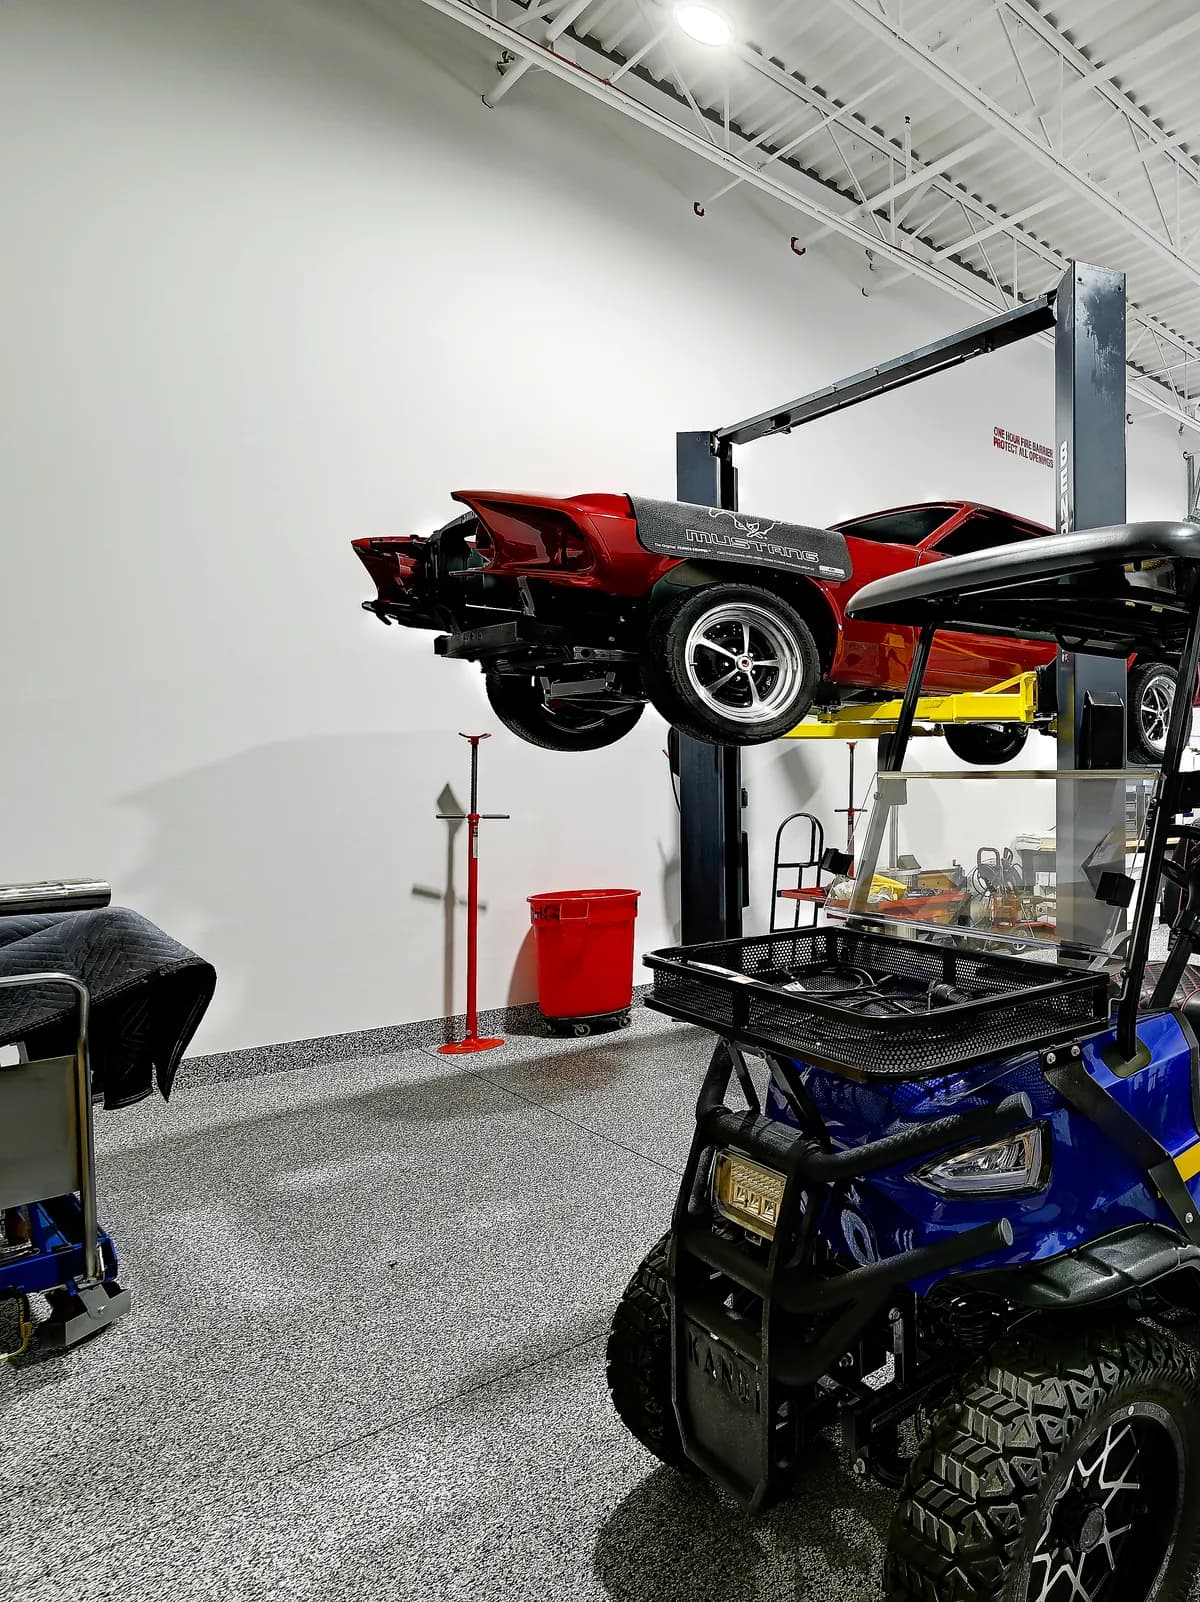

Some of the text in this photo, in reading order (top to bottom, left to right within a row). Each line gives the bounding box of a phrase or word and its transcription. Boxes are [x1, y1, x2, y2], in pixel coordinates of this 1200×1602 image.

[993, 426, 1053, 459] ONE HOUR FIRE BARRIER
[993, 436, 1054, 469] PROTECT ALL OPENINGS
[686, 528, 819, 563] MUSTANG
